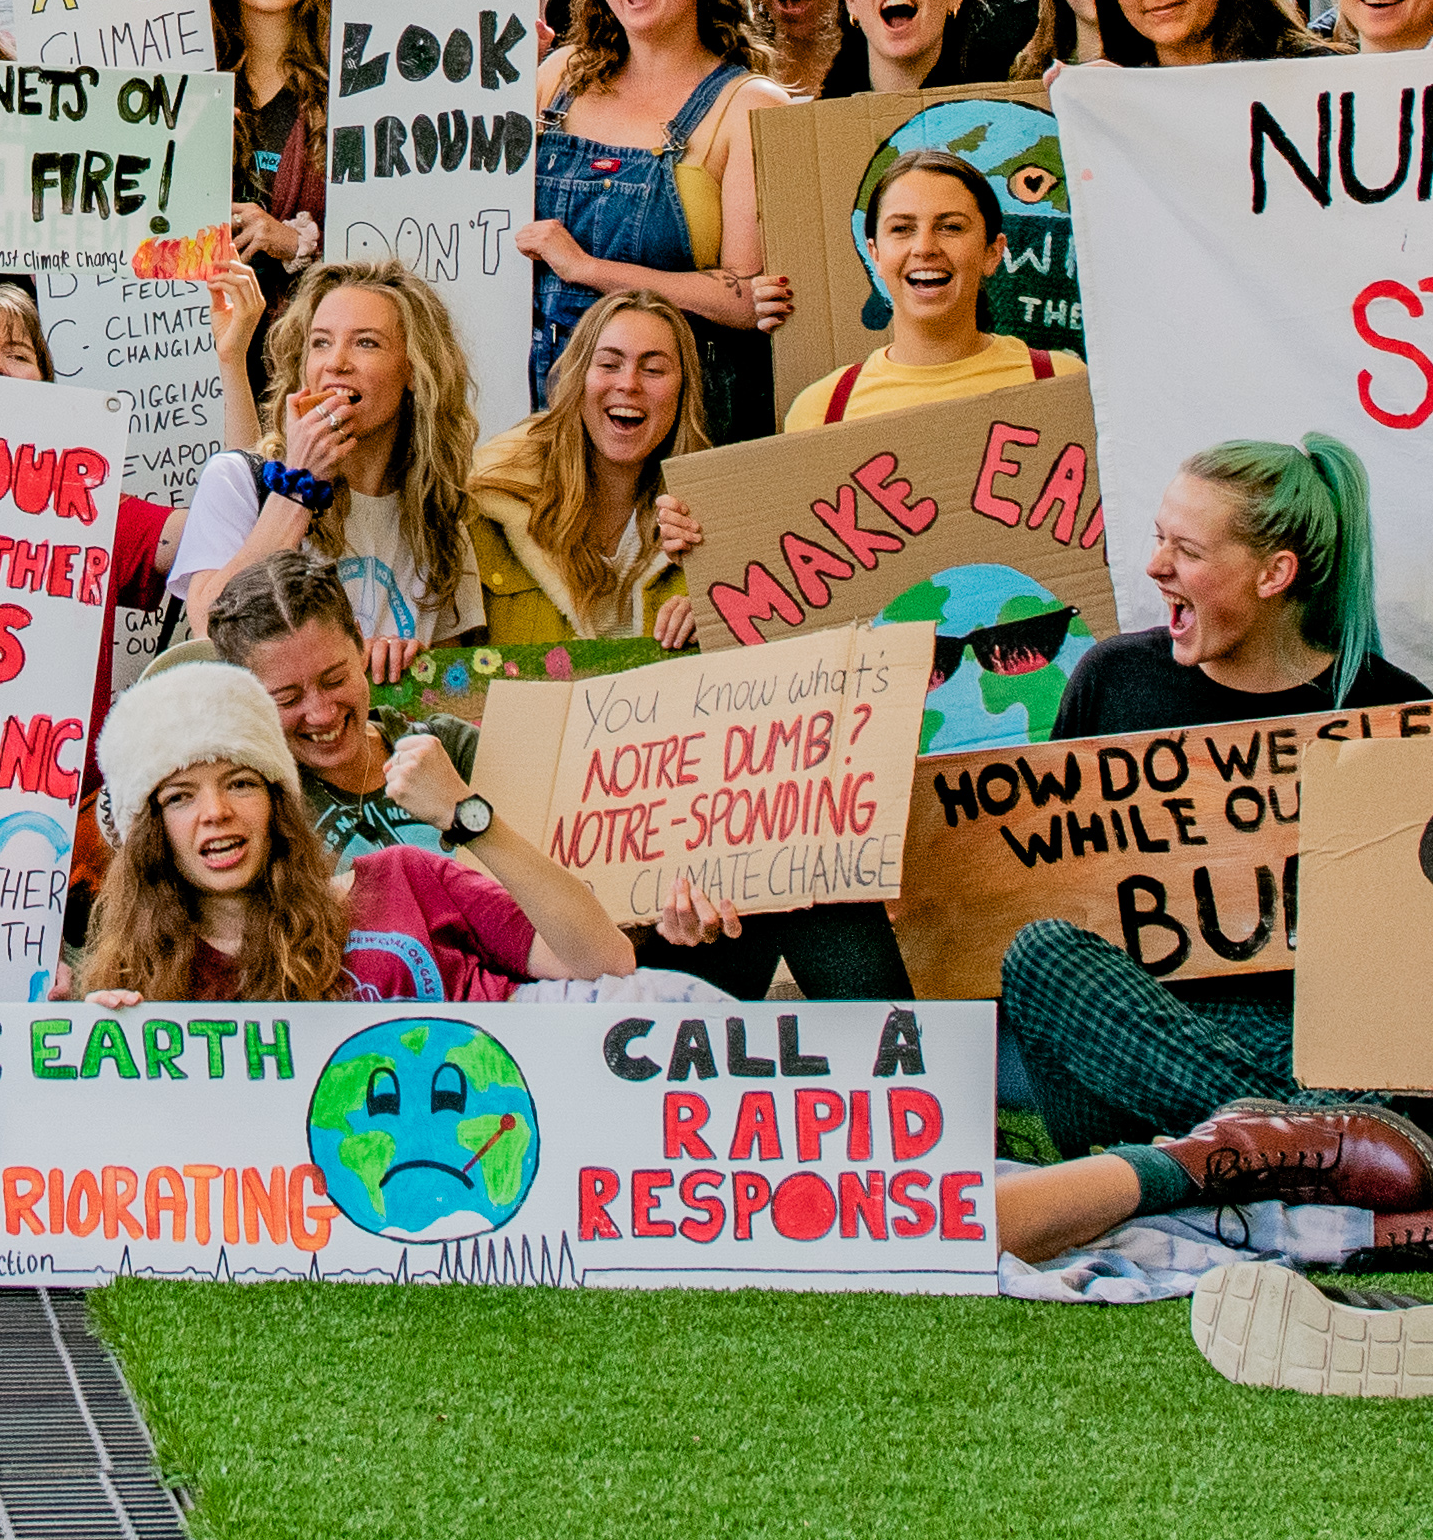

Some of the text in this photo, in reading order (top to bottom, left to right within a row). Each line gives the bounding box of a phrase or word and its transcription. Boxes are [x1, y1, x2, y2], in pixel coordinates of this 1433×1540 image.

[40, 11, 204, 67] CLIMATE
[340, 9, 528, 96] LOOK
[118, 74, 187, 131] ON
[331, 110, 532, 185] AROUND
[30, 141, 175, 234] FIRE!
[106, 305, 211, 340] CLIMATE
[709, 452, 937, 646] MAKE
[585, 651, 890, 746] You know what's
[582, 730, 705, 803] NOTRE
[934, 727, 1299, 828] HOW DO WE
[769, 834, 901, 897] CHANGE
[999, 798, 1208, 869] WHILE
[30, 1017, 295, 1082] EARTH
[603, 1005, 923, 1082] CALL A
[664, 1088, 944, 1163] RAPID
[578, 1168, 984, 1242] RESPONSE
